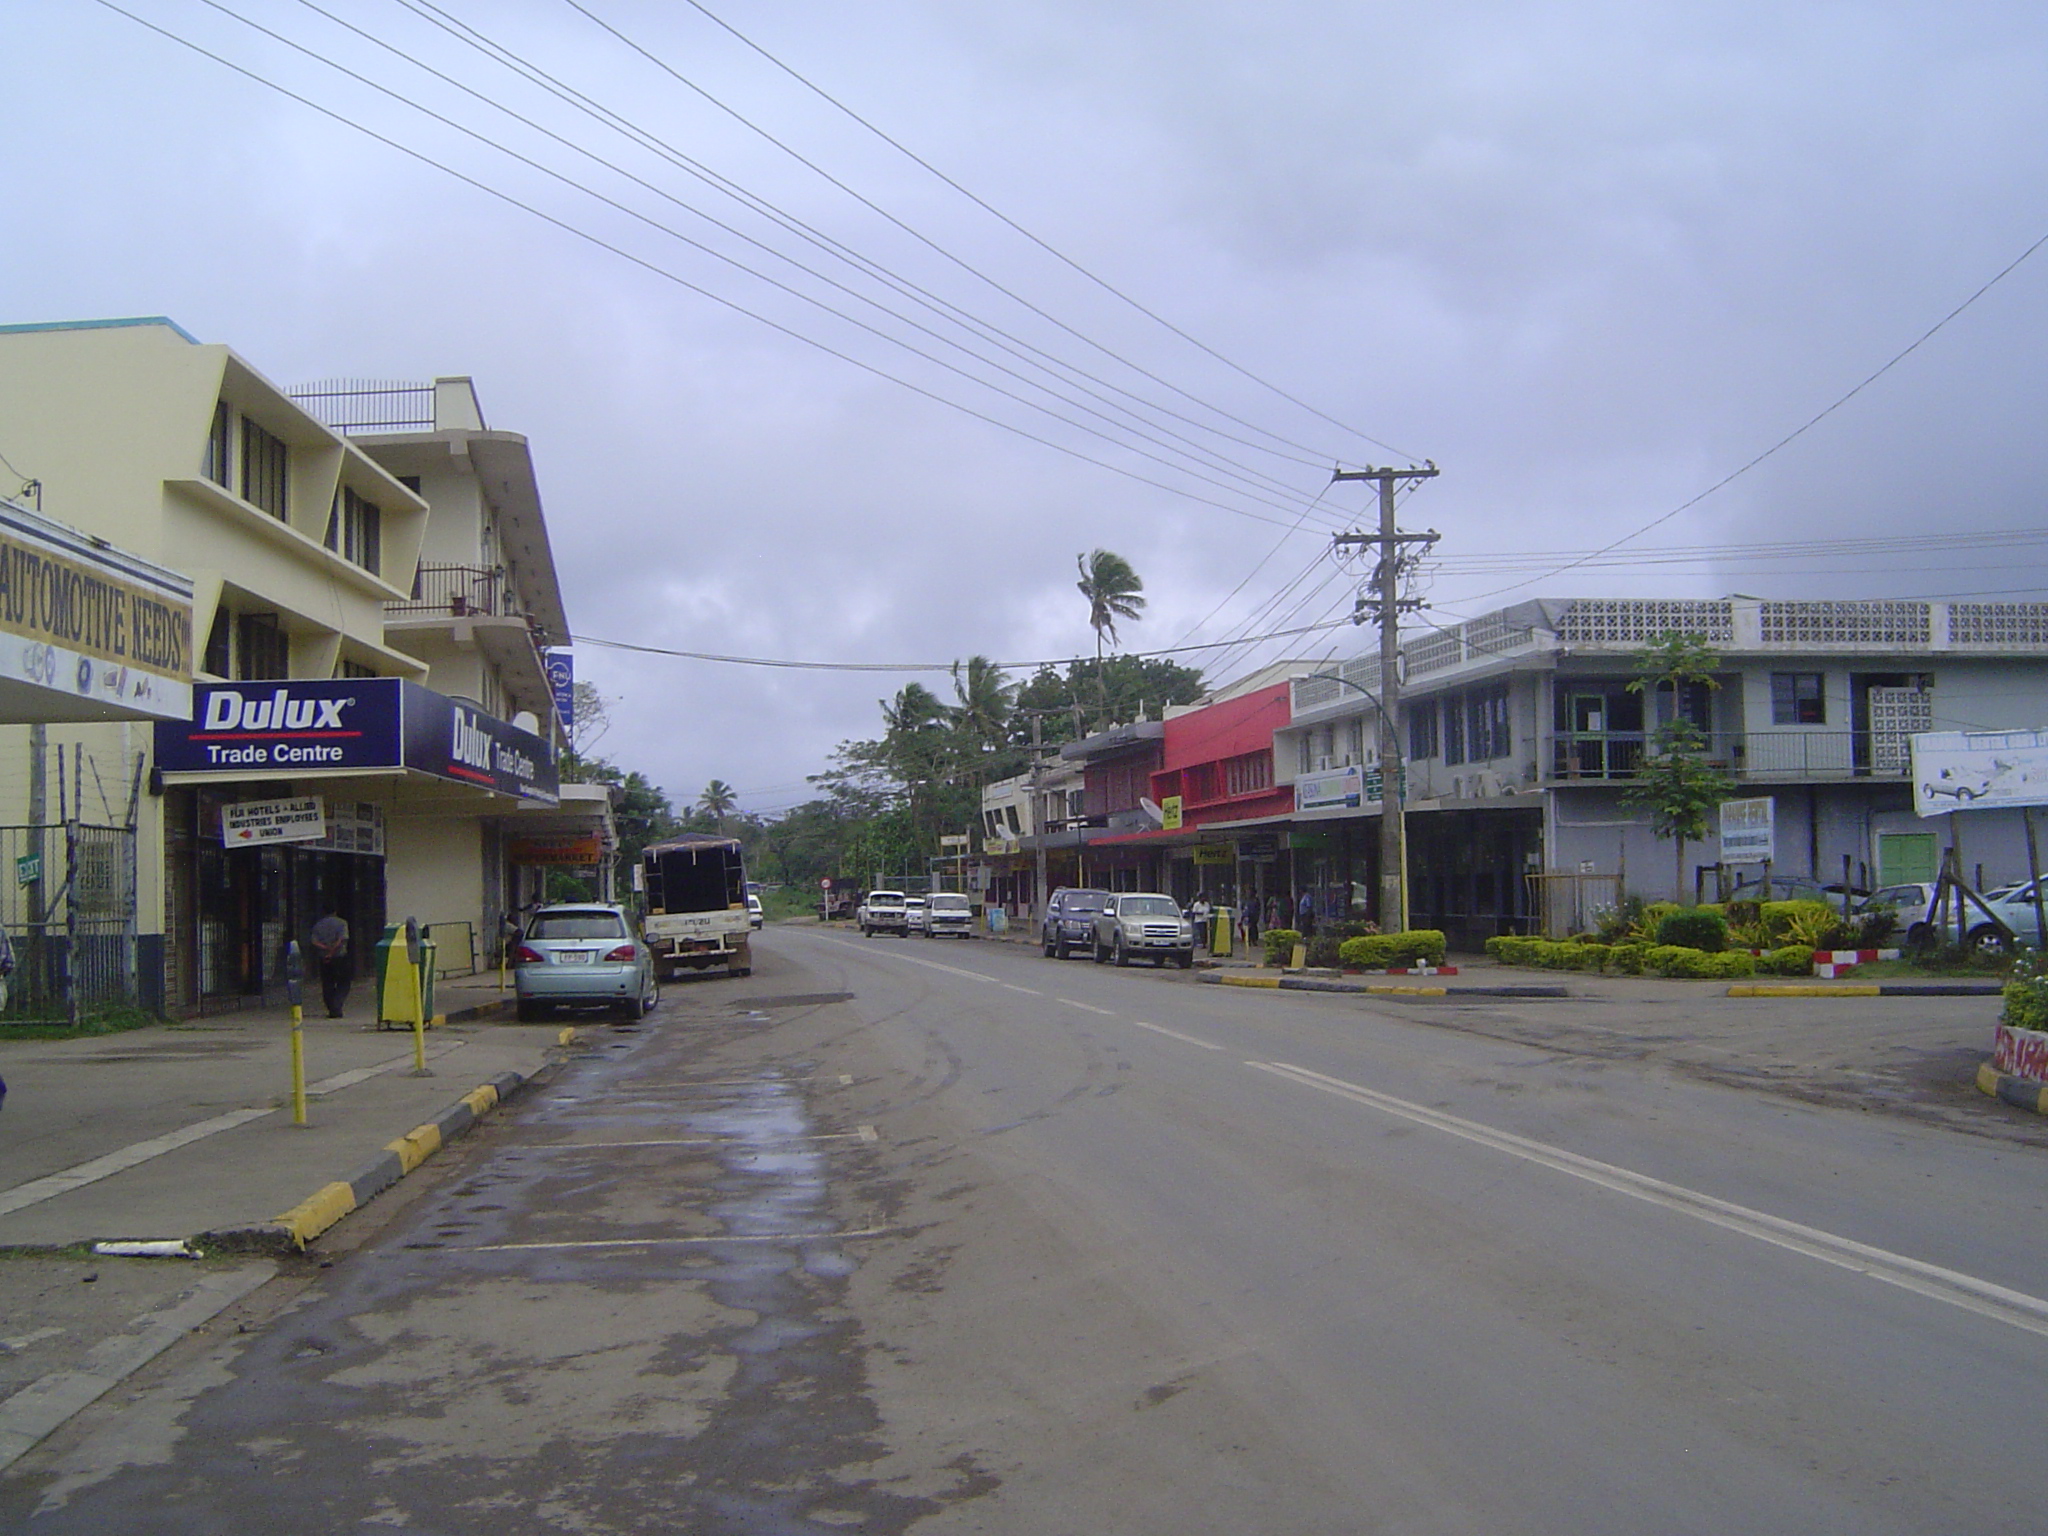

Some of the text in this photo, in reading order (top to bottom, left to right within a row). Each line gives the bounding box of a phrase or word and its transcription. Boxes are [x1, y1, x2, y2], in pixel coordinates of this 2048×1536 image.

[0, 542, 125, 656] AUTOMOTIVE
[204, 689, 347, 730] Dulux
[453, 707, 492, 771] Dulux
[207, 744, 343, 763] Trade Centre
[248, 805, 281, 817] HOTELS
[289, 802, 316, 812] ALLIED
[229, 812, 318, 828] INDUSTRIES EMPLOYEES
[260, 828, 283, 837] UNION
